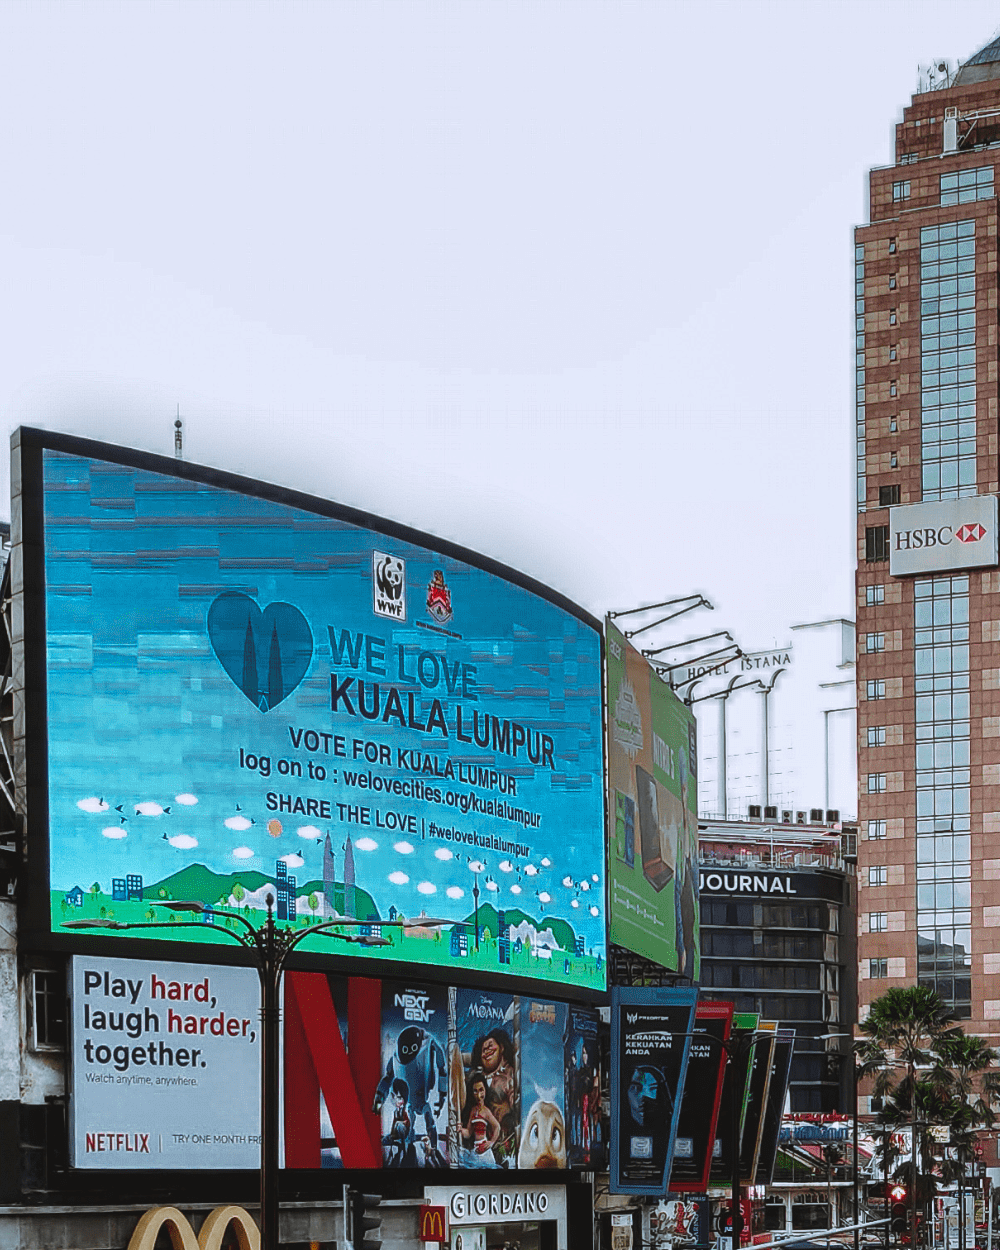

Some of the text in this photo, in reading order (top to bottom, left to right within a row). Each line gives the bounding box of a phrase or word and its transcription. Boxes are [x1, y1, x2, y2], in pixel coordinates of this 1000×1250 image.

[894, 526, 953, 550] HSBC
[377, 598, 403, 616] WWF
[327, 625, 478, 702] WE LOVE
[687, 653, 791, 679] HOTEL ISTANA
[330, 672, 449, 737] KUALA
[456, 705, 556, 770] LUMPUR
[288, 726, 517, 796] VOTE FOR KUALA LUMPUR
[239, 748, 271, 777] log
[277, 759, 302, 777] on
[307, 761, 326, 781] to
[343, 770, 541, 828] welovecities.org/kualalumpur
[266, 792, 332, 819] SHARE
[336, 802, 371, 825] THE
[375, 809, 417, 834] LOVE
[429, 822, 530, 857] #welovekualalumpur
[699, 873, 797, 894] JOURNAL
[83, 970, 217, 1008] Play hard,
[394, 993, 430, 1009] NEXT
[404, 1008, 435, 1023] GEN
[467, 1001, 505, 1020] MOANA
[83, 1003, 256, 1043] laugh harder,
[625, 1033, 673, 1041] KERAHKAN
[625, 1041, 672, 1049] KEKUATAN
[83, 1039, 207, 1071] together.
[625, 1048, 651, 1056] ANDA
[85, 1073, 198, 1087] Watch anytime, anywhere.
[85, 1133, 150, 1153] NETFLIX
[172, 1134, 190, 1144] TRY
[191, 1134, 211, 1144] ONE
[213, 1135, 246, 1144] MONTH
[450, 1192, 549, 1218] GIORDANO
